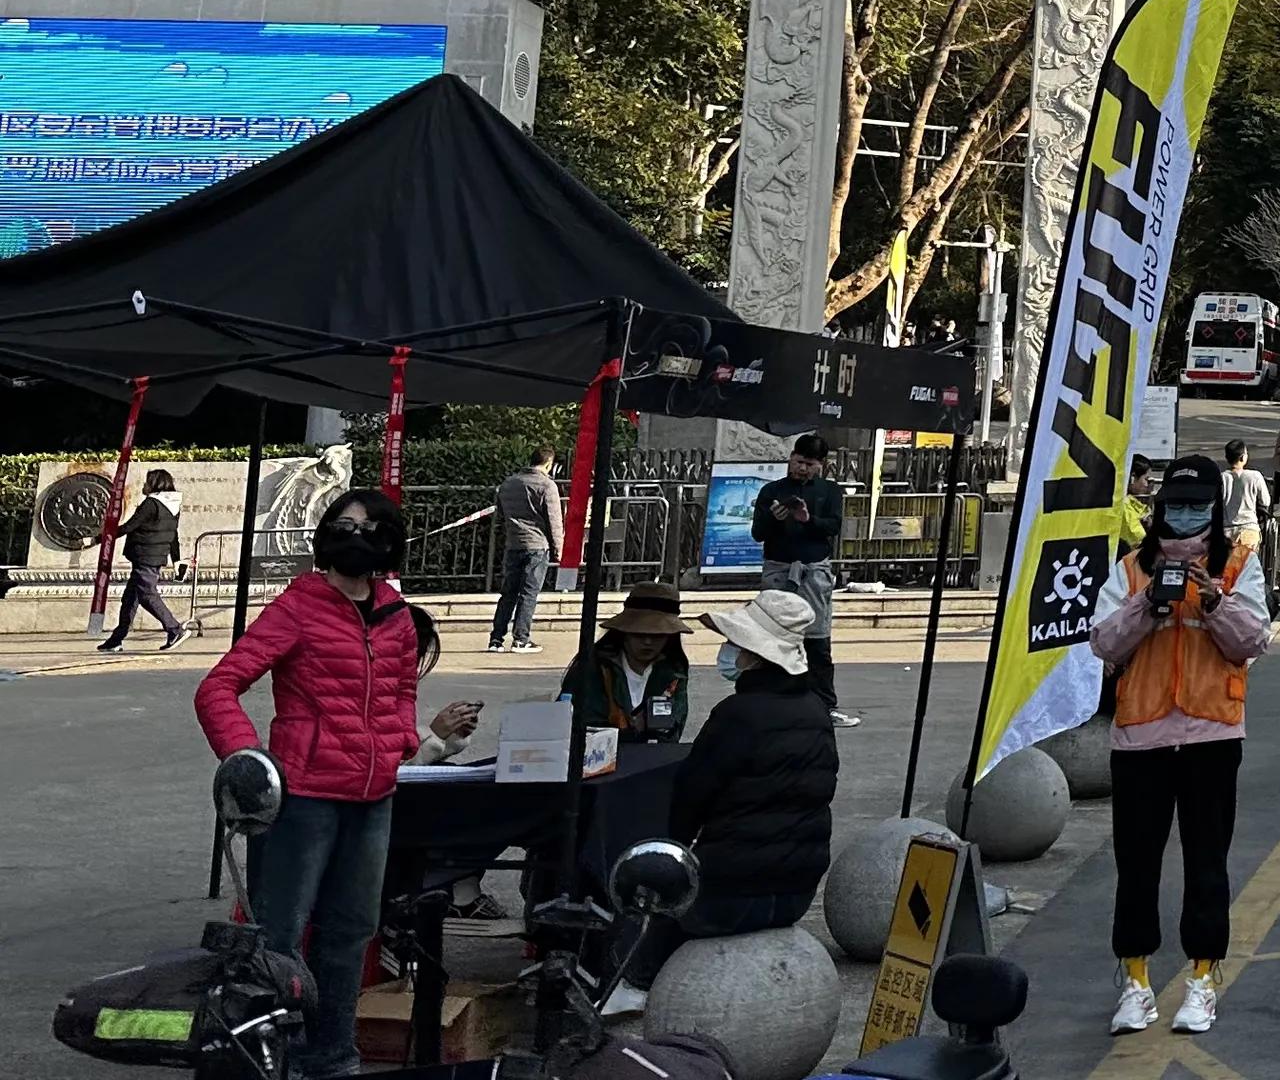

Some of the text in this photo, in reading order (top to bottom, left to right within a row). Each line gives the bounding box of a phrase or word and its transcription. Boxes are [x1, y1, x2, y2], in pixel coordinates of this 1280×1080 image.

[1043, 58, 1161, 514] FUGA
[1134, 116, 1175, 324] POWER GRIP
